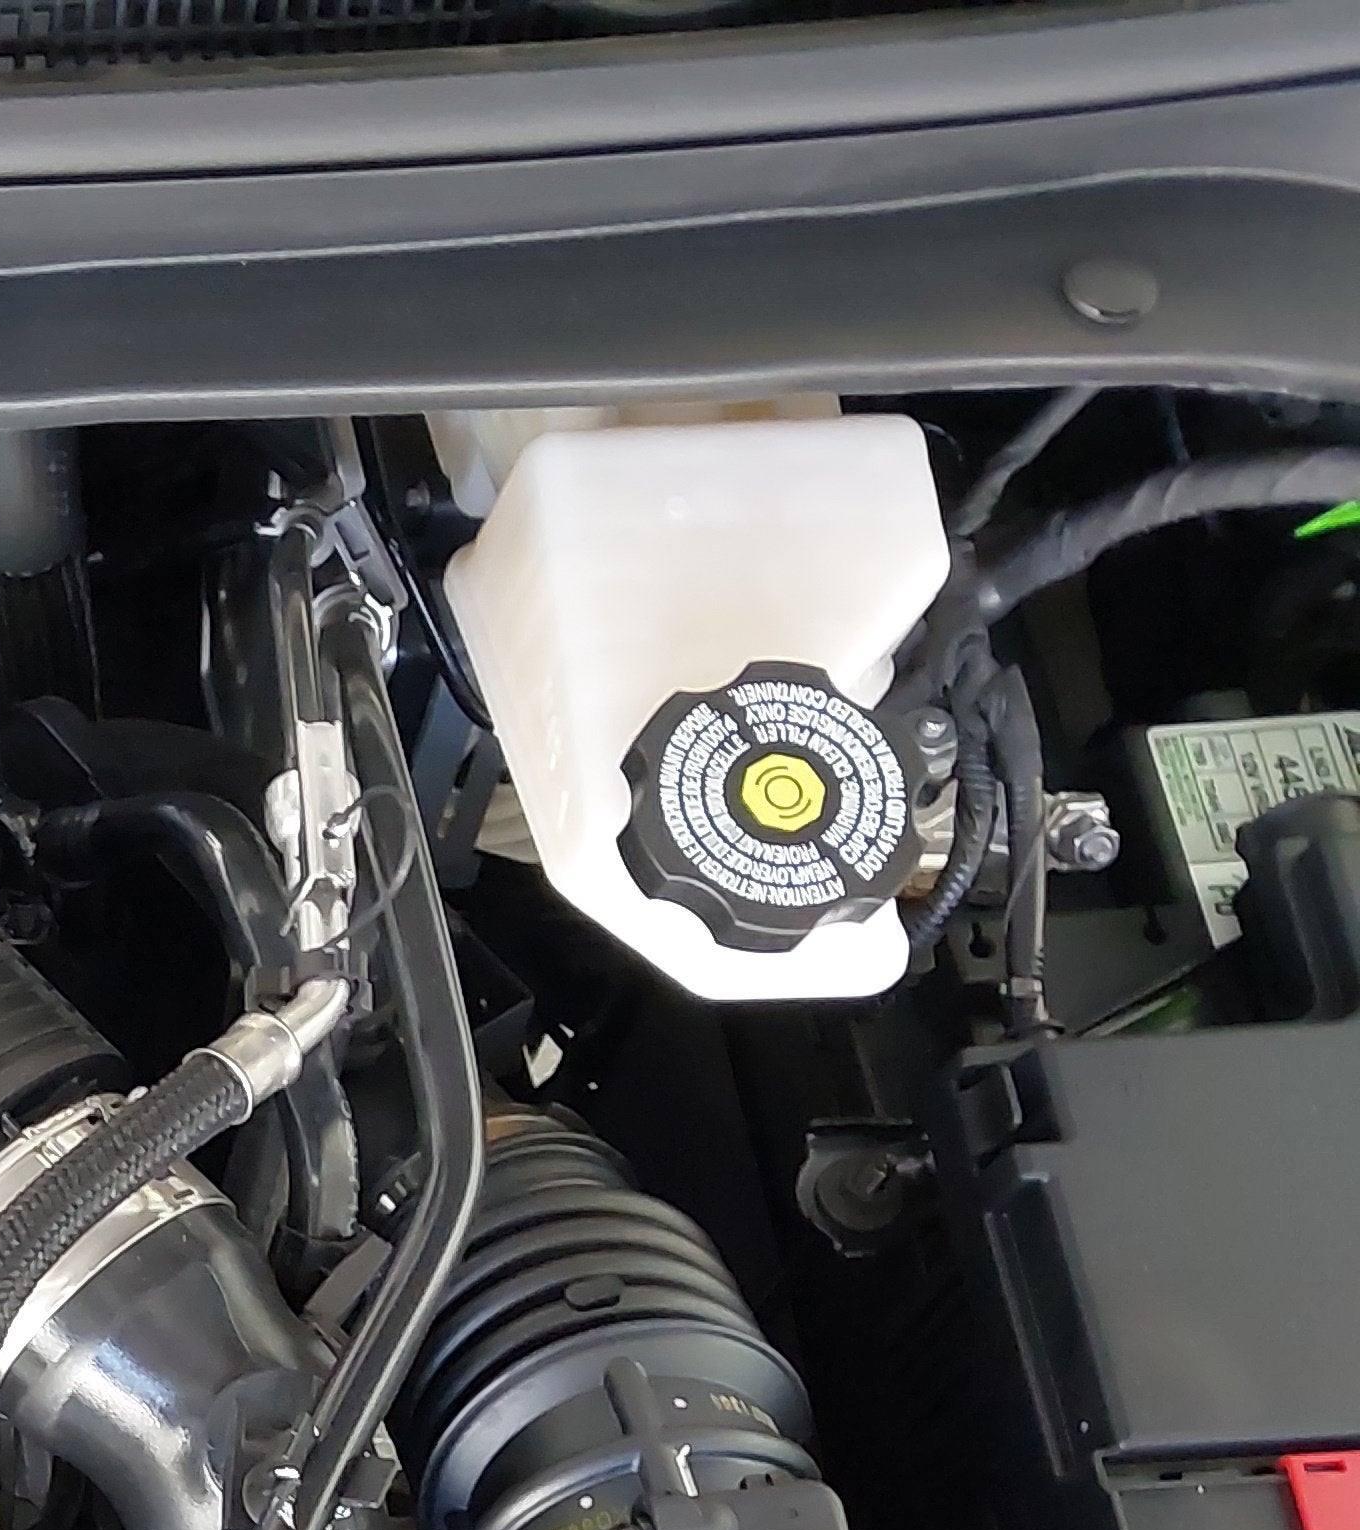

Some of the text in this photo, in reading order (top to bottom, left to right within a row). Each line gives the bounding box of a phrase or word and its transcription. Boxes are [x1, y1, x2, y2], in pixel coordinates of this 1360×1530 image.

[745, 702, 787, 726] ONLY
[699, 719, 730, 748] DOT
[718, 714, 738, 732] 4
[752, 720, 810, 746] FILLER
[682, 842, 708, 865] LE
[839, 831, 869, 865] CAP
[854, 845, 889, 881] DOT
[872, 838, 895, 855] 4
